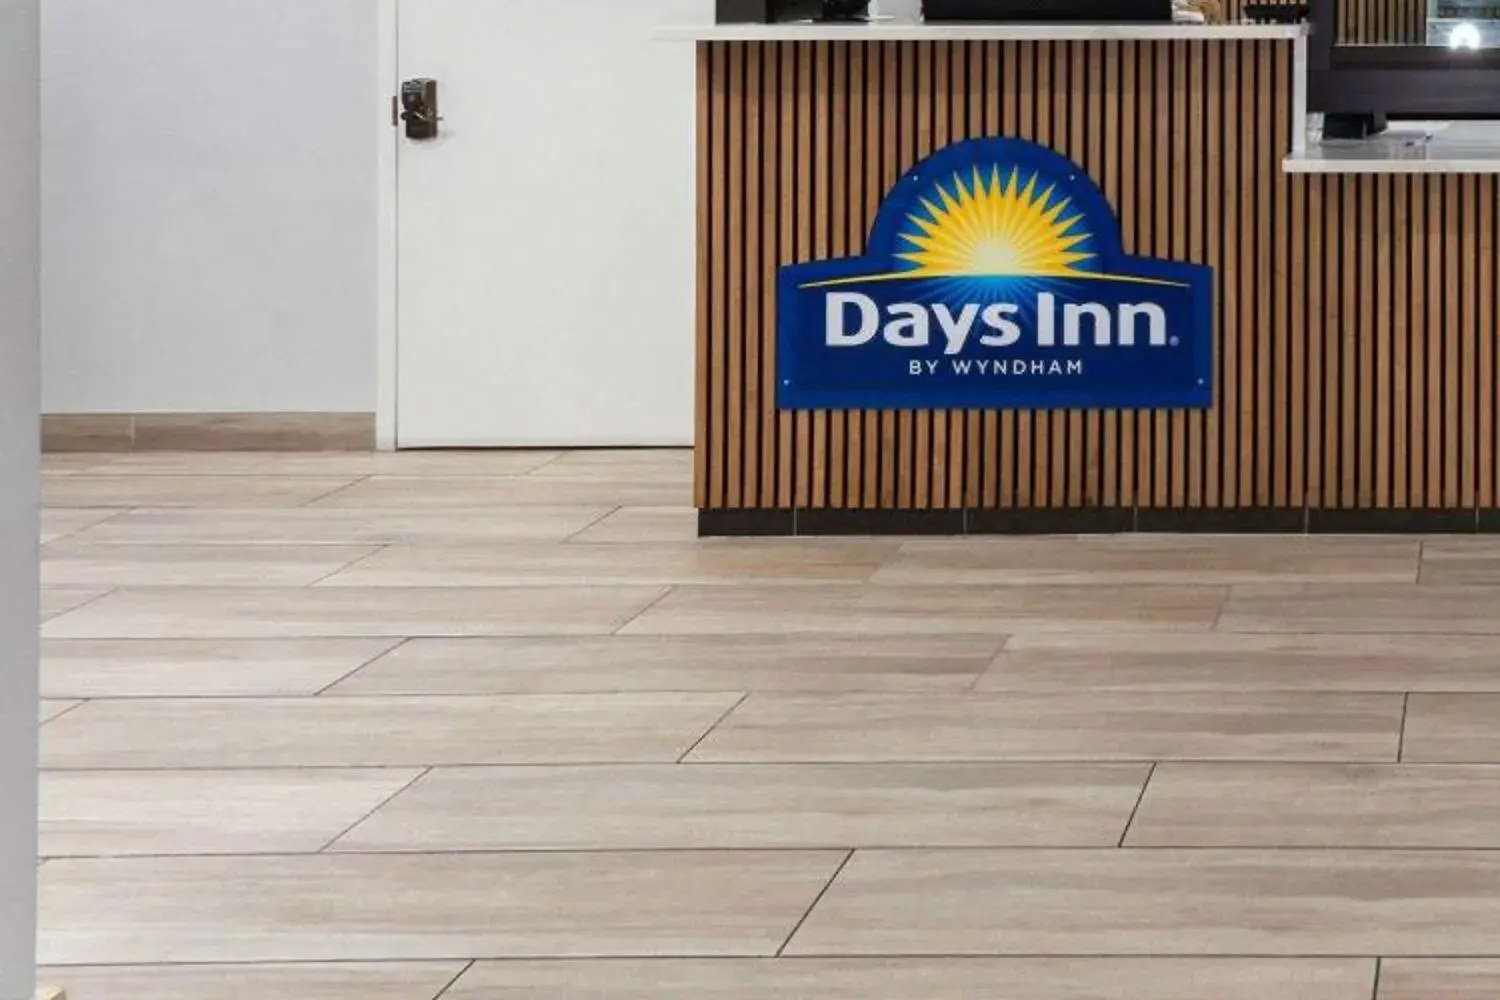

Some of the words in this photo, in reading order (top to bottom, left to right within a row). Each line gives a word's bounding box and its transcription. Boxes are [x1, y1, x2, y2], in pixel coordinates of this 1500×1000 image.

[825, 291, 1021, 355] Days
[1037, 291, 1168, 347] Inn
[908, 359, 938, 375] BY
[953, 359, 1084, 375] WYNDHAM
